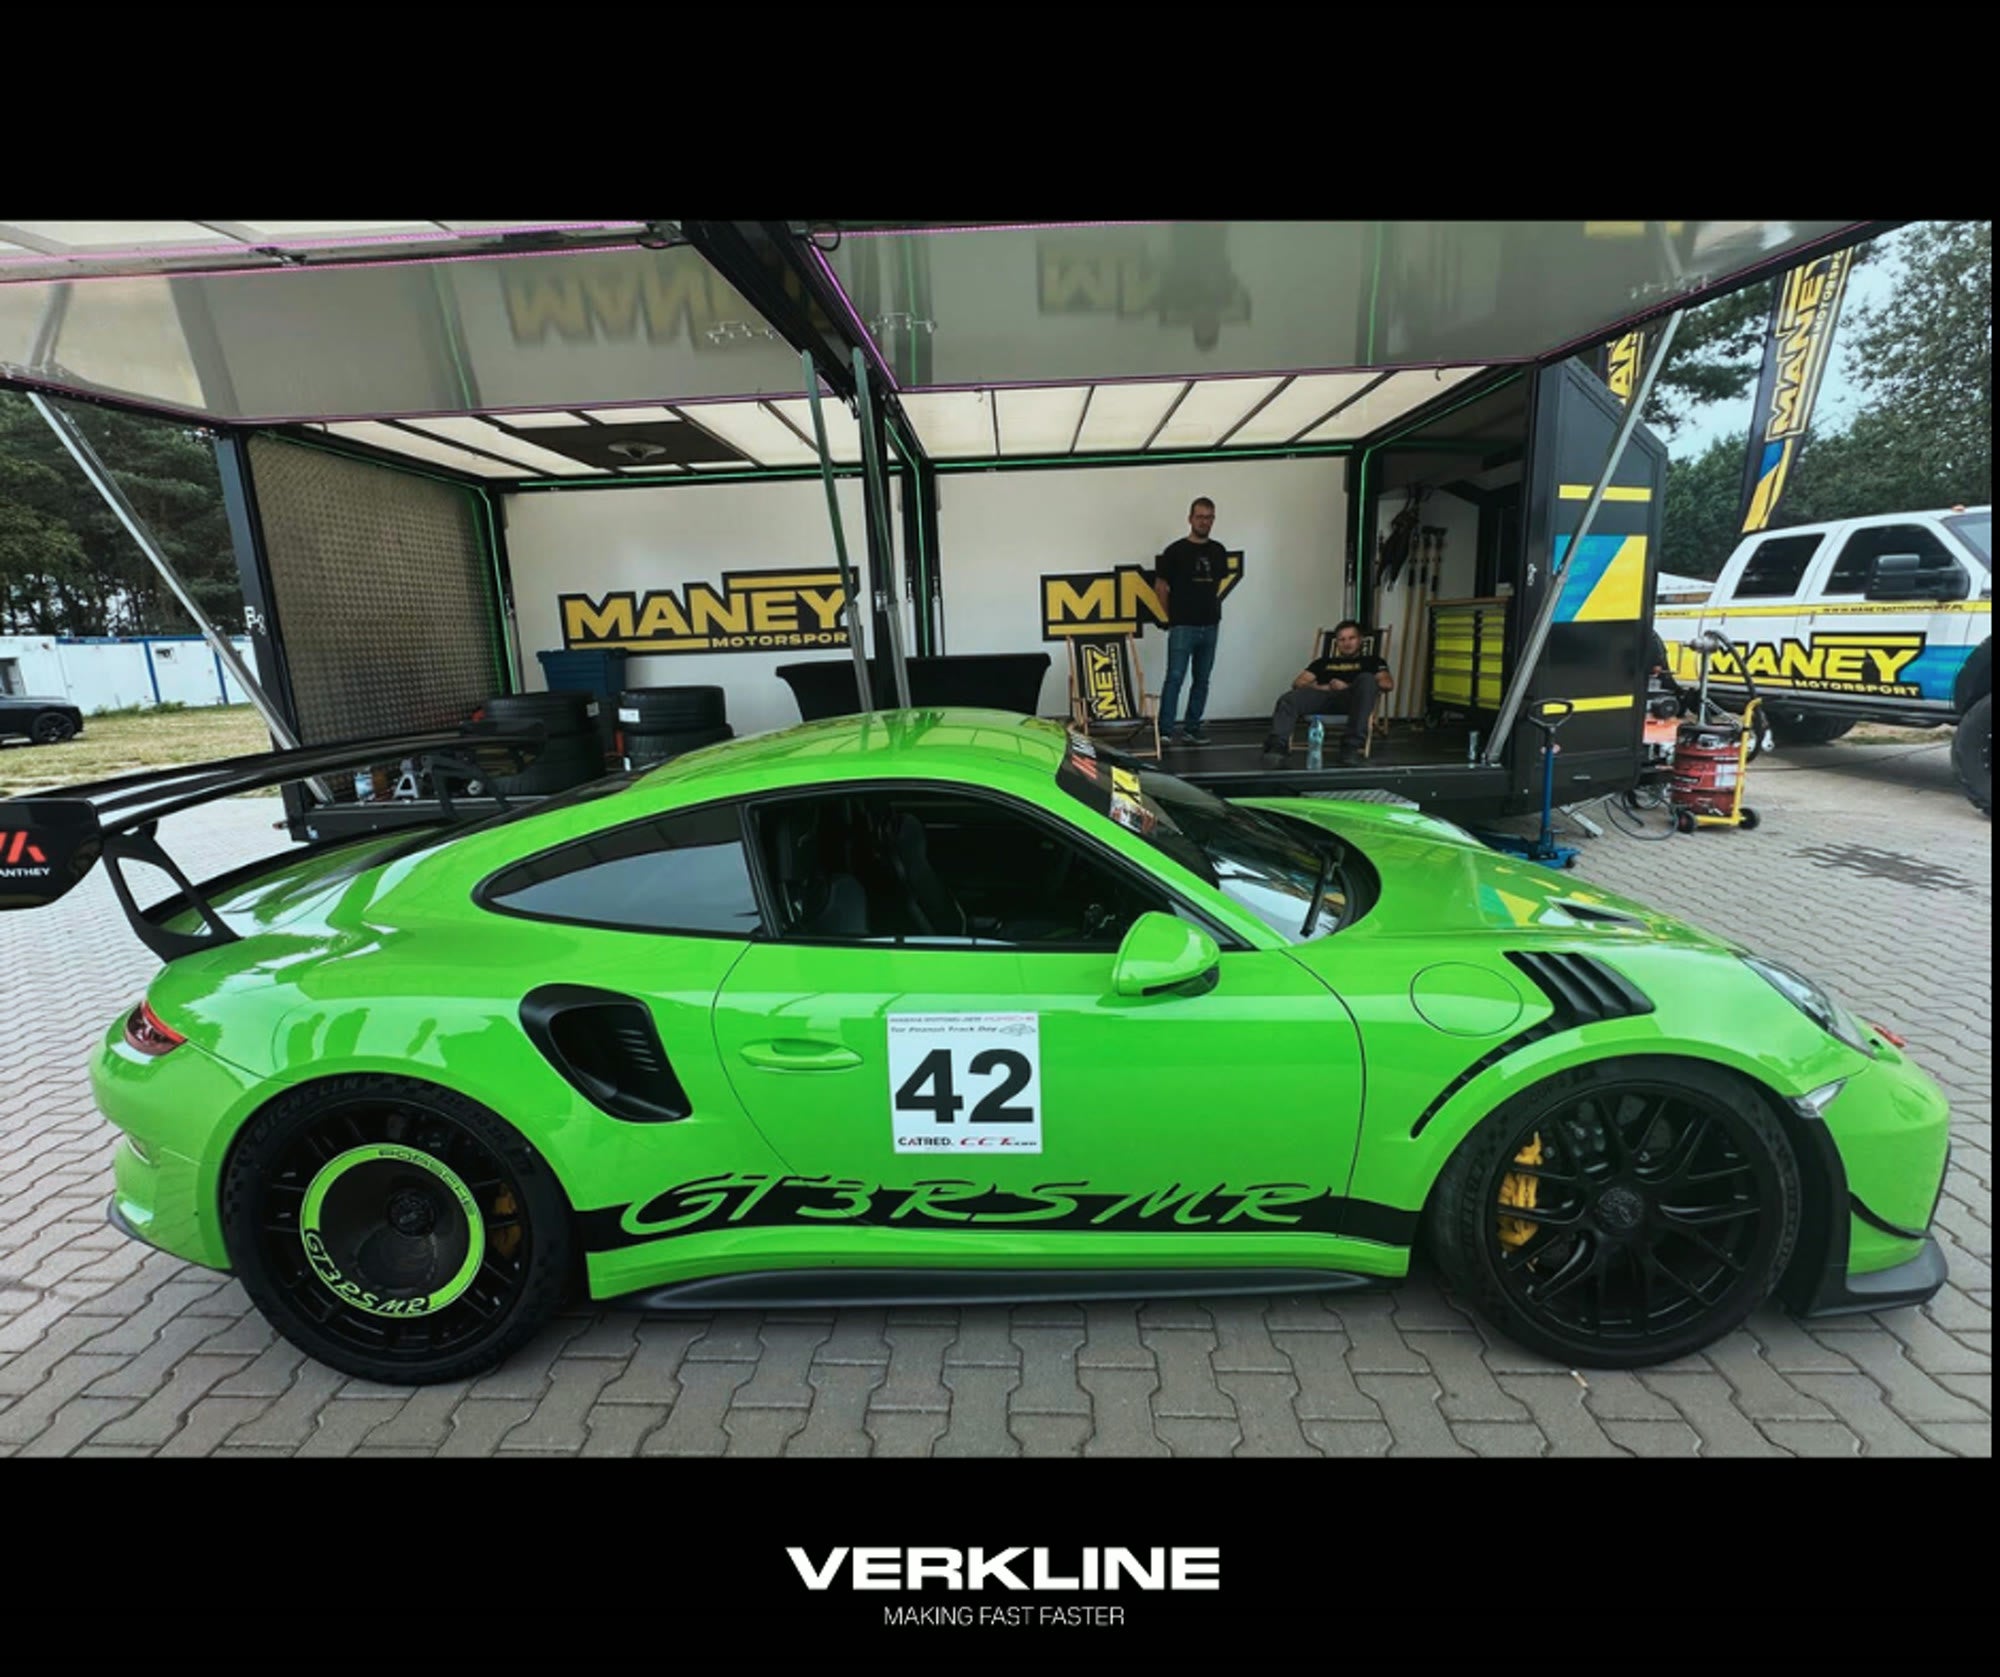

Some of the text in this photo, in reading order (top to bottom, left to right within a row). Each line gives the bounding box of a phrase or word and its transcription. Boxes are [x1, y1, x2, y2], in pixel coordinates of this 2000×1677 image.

[564, 587, 846, 639] MANEY
[712, 632, 848, 648] MOTORSPOR
[1709, 643, 1920, 683] MANEY
[1794, 679, 1919, 697] MOTORSPORT
[895, 1048, 1034, 1123] 42
